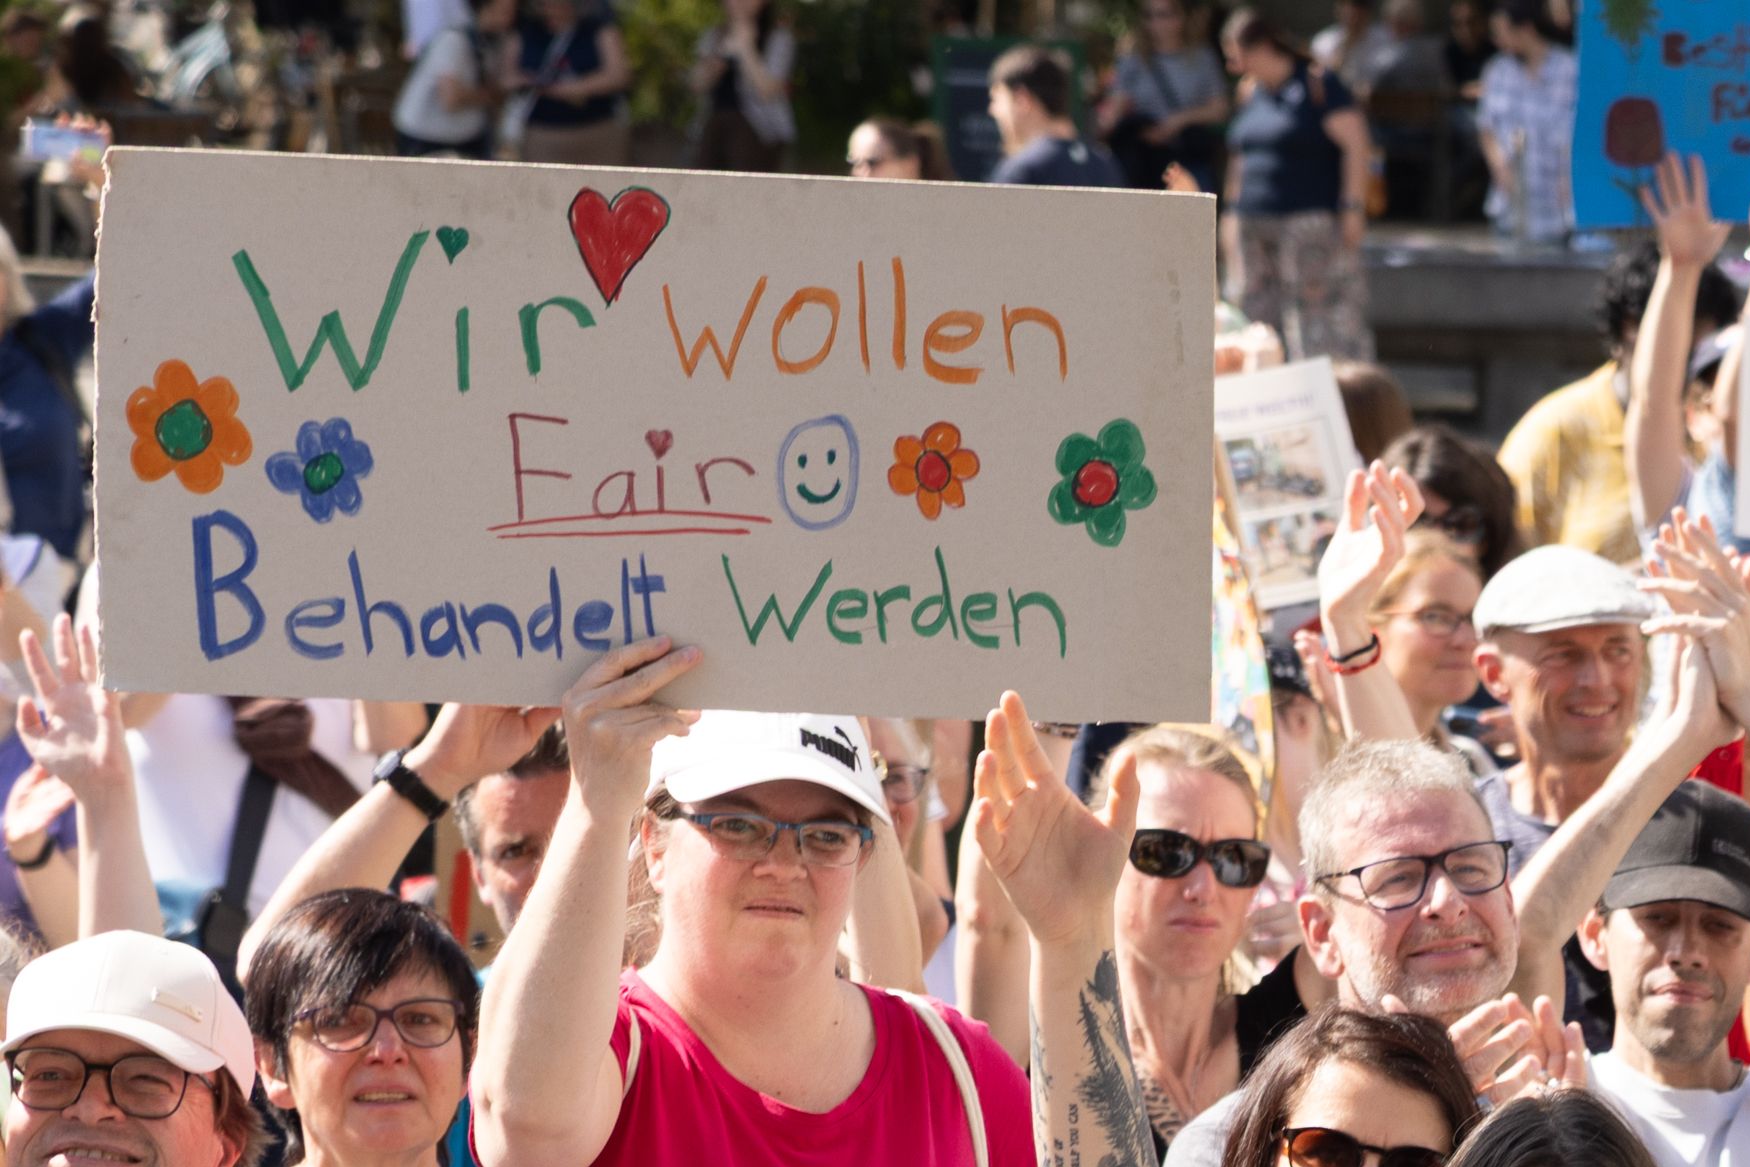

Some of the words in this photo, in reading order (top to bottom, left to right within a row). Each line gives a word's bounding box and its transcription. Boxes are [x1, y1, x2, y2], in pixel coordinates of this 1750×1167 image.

[232, 226, 597, 394] Wir
[508, 413, 758, 524] Fair
[192, 511, 665, 661] Behandelt
[722, 546, 1067, 658] Werden
[1069, 1103, 1079, 1125] CAN
[1069, 1128, 1080, 1147] YOU
